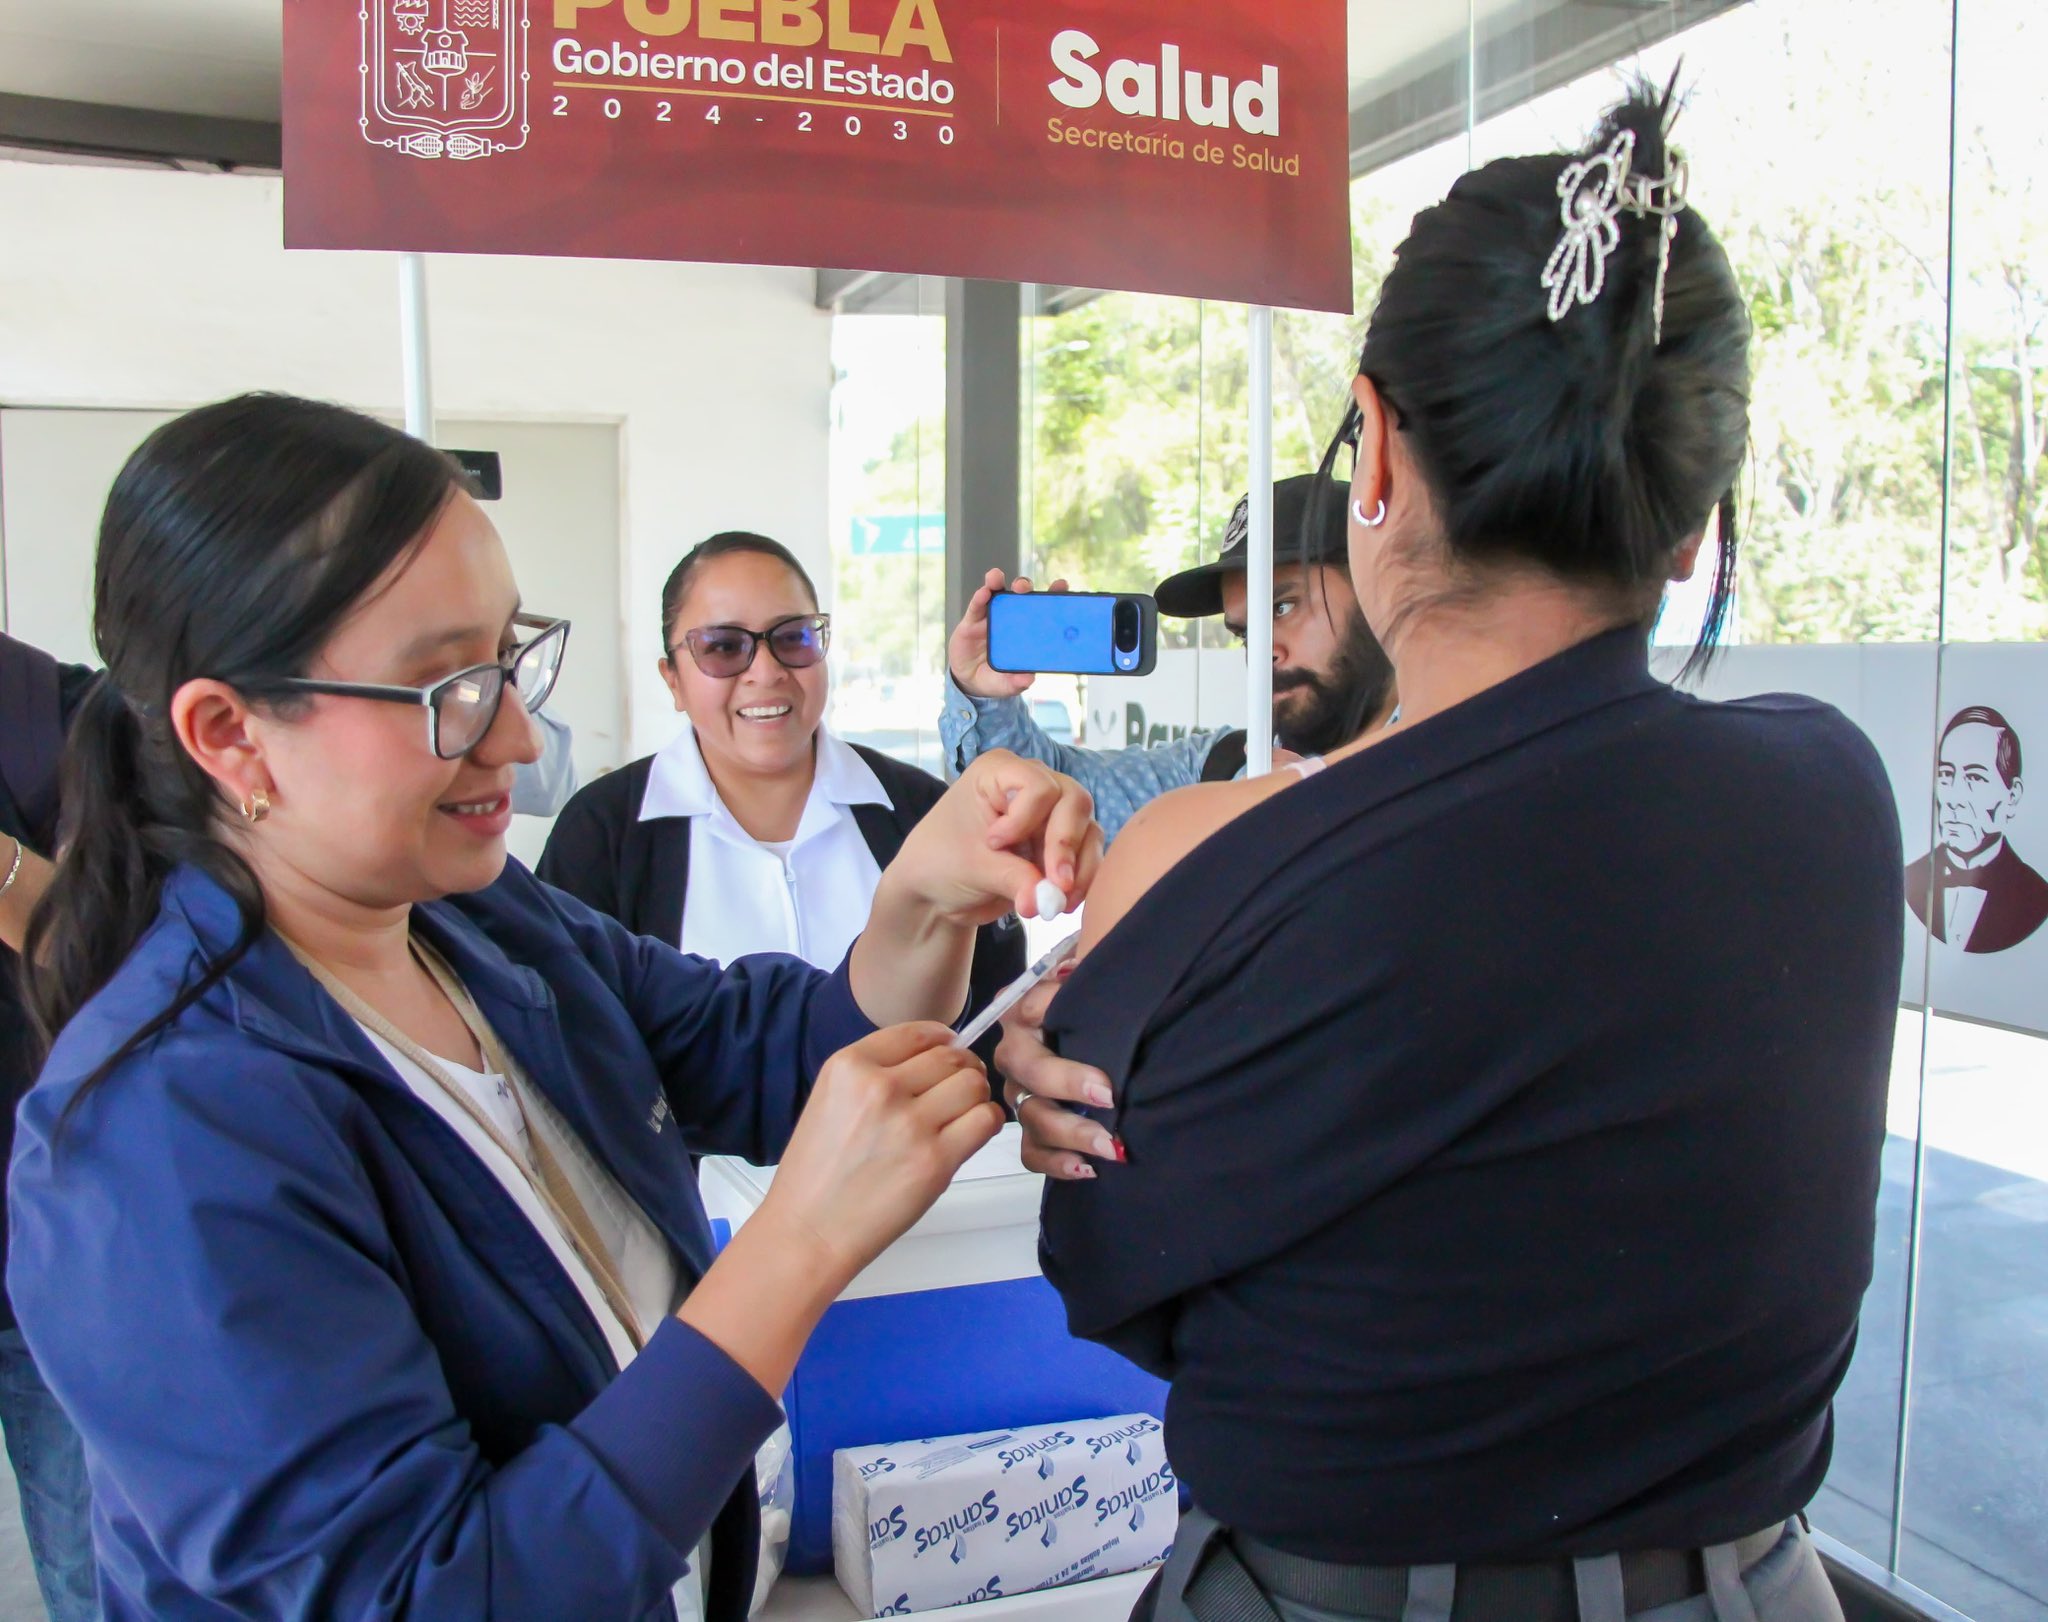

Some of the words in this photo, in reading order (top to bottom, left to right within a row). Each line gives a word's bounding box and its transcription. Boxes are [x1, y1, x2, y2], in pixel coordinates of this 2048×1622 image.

[552, 38, 746, 85] Gobierno
[753, 53, 813, 90] del
[823, 59, 954, 105] Estado
[1047, 29, 1280, 137] Salud
[1047, 118, 1184, 159] Secretaría
[1193, 139, 1225, 166] de
[1232, 144, 1300, 177] Salud
[998, 1431, 1075, 1469] Sanitas
[1086, 1420, 1161, 1455] Sanitas
[914, 1489, 1000, 1554] Sanitas
[1006, 1475, 1089, 1538] Sanitas
[1095, 1462, 1175, 1522] Sanitas
